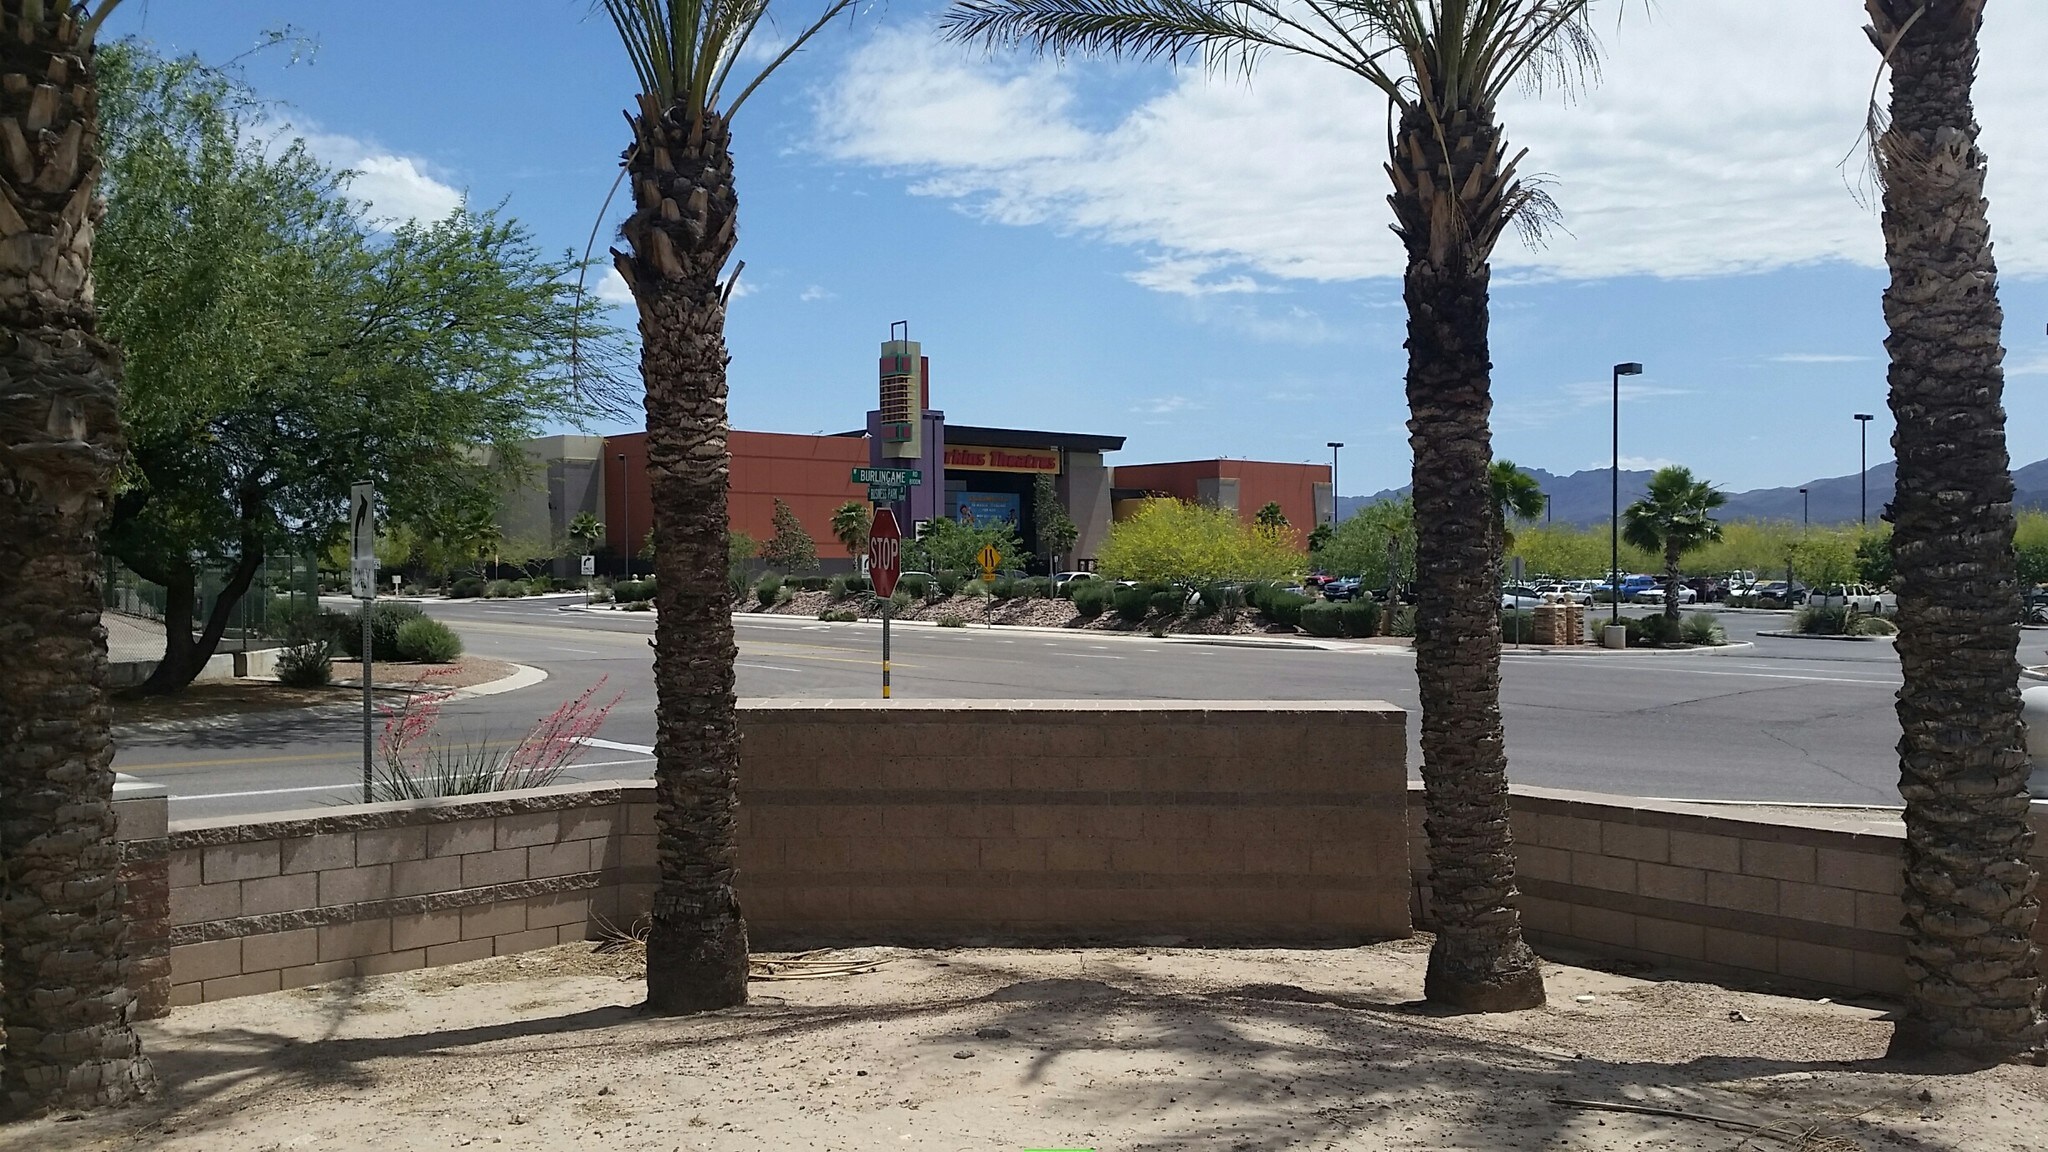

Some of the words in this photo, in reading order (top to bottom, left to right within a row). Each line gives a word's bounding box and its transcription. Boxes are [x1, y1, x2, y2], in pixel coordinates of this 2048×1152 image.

[944, 450, 985, 466] rkins
[990, 450, 1056, 469] Theatres
[860, 469, 906, 484] BURLINGAME
[870, 488, 887, 500] BUSINESS
[887, 488, 898, 500] PARK
[870, 537, 898, 571] STOP
